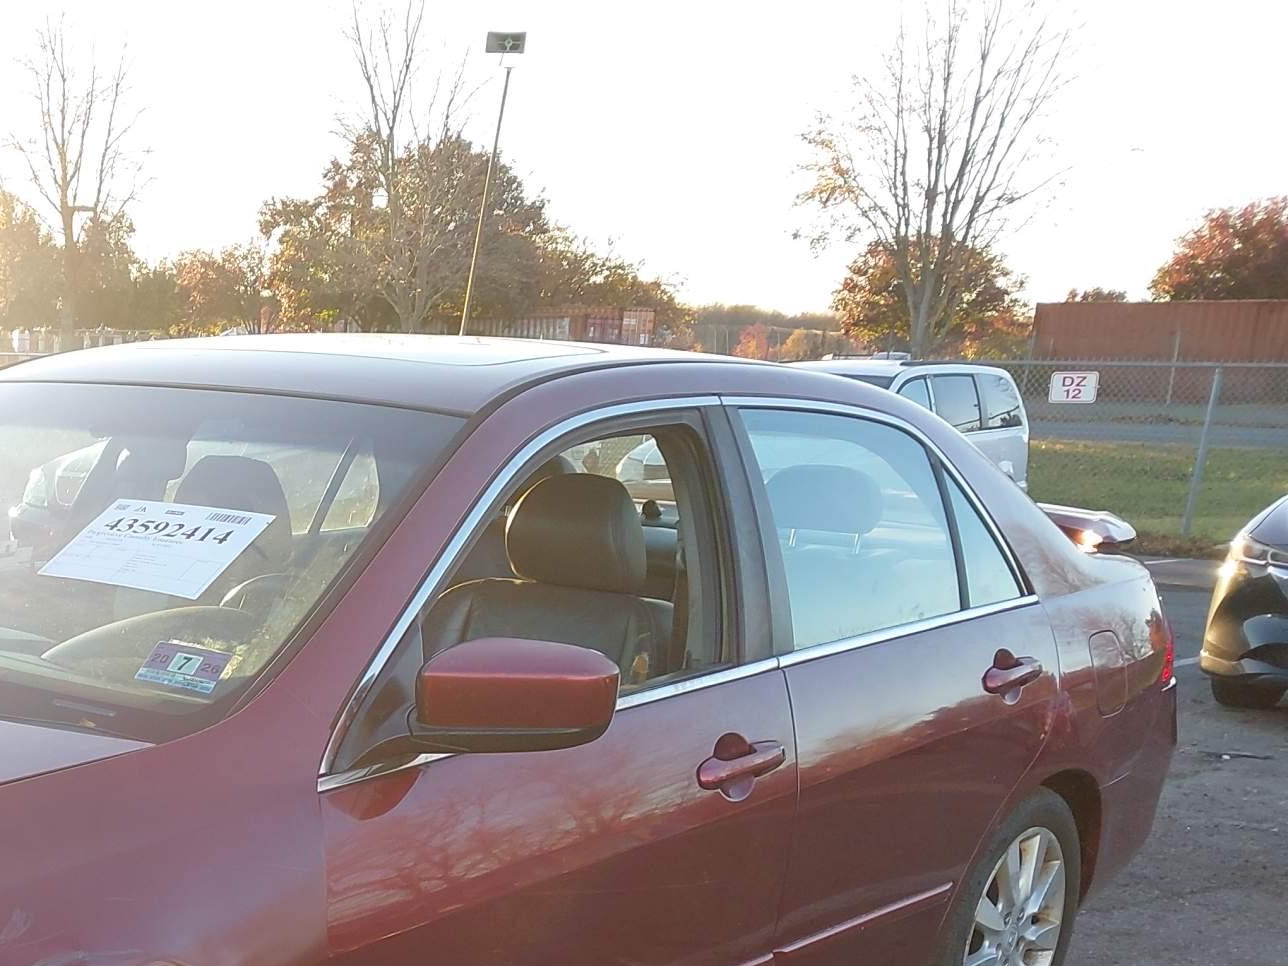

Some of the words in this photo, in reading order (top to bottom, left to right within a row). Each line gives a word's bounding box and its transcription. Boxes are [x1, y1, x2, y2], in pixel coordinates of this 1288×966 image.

[1062, 375, 1088, 388] DZ
[1063, 388, 1083, 400] 12
[103, 516, 234, 545] 43592414
[152, 653, 170, 664] 20
[177, 656, 193, 671] 7
